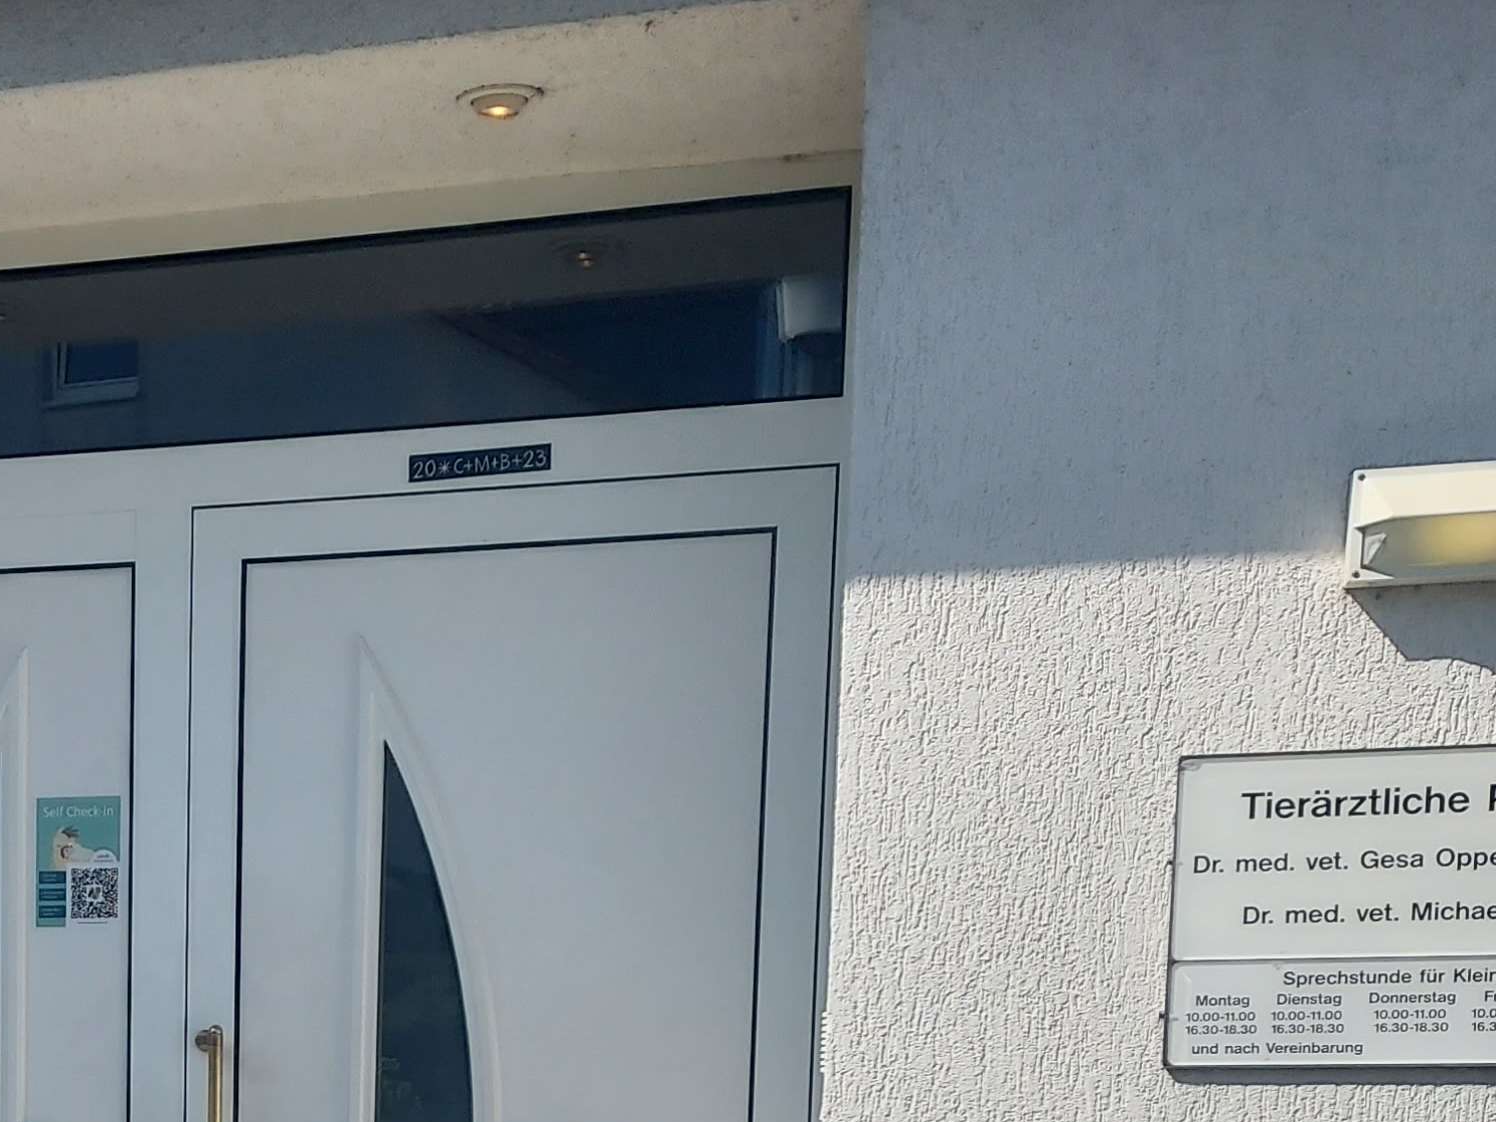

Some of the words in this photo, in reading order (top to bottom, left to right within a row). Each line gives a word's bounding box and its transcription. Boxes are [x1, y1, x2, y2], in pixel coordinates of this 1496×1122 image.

[1241, 786, 1469, 819] Tierärztliche
[1194, 856, 1224, 873] Dr.
[1236, 853, 1294, 872] med.
[1306, 852, 1348, 870] vet.
[1361, 851, 1423, 869] Gesa
[1243, 907, 1273, 924] Dr.
[1286, 904, 1344, 923] med.
[1357, 904, 1399, 922] vet.
[1283, 969, 1412, 988] Sprechstunde
[1420, 969, 1445, 983] für
[1196, 995, 1249, 1008] Montag
[1277, 994, 1341, 1006] Dienstag
[1369, 992, 1456, 1005] Donnerstag
[1485, 991, 1496, 1002] F
[1186, 1012, 1256, 1022] 10.00-11.00
[1271, 1010, 1342, 1021] 10.00-11.00
[1374, 1009, 1446, 1019] 10.00-11.00
[1185, 1025, 1257, 1035] 16.30-18.30
[1272, 1024, 1344, 1034] 16.30-18.30
[1374, 1022, 1448, 1032] 16.30-18.30
[1192, 1043, 1218, 1054] und
[1225, 1043, 1259, 1054] nach
[1266, 1042, 1363, 1055] Vereinbarung
